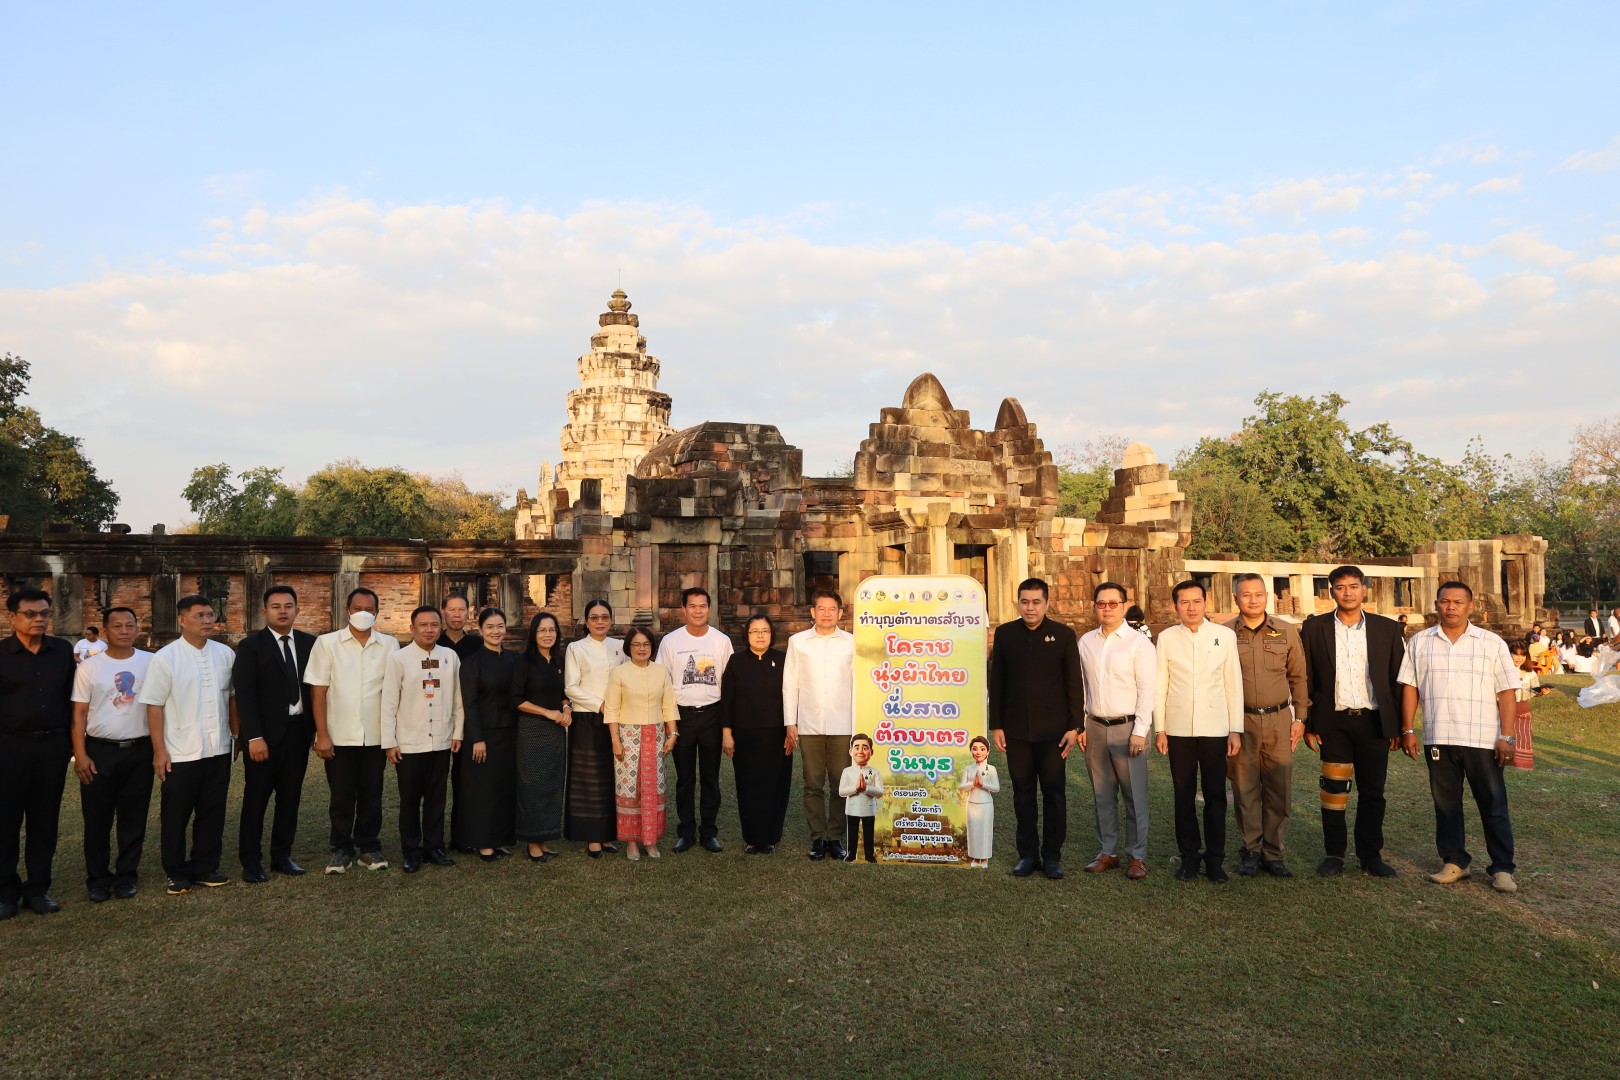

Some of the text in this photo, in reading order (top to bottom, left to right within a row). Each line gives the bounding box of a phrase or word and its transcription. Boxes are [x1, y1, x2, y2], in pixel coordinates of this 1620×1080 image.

[859, 611, 980, 629] ทำบุญตักบาตรสัญจร
[886, 634, 951, 654] โคราช
[873, 661, 967, 689] นุ่งผ้าไทย
[884, 688, 957, 715] นั่งสาด
[875, 722, 966, 743] ตักบาตร
[889, 749, 951, 779] วันพุธ
[893, 788, 927, 798] ครอบครัว
[911, 801, 942, 814] หิ้วตะกร้า
[895, 816, 941, 830] ศรัทธาอิ่มบุญ
[901, 834, 953, 845] อุดหนุนชุมชน
